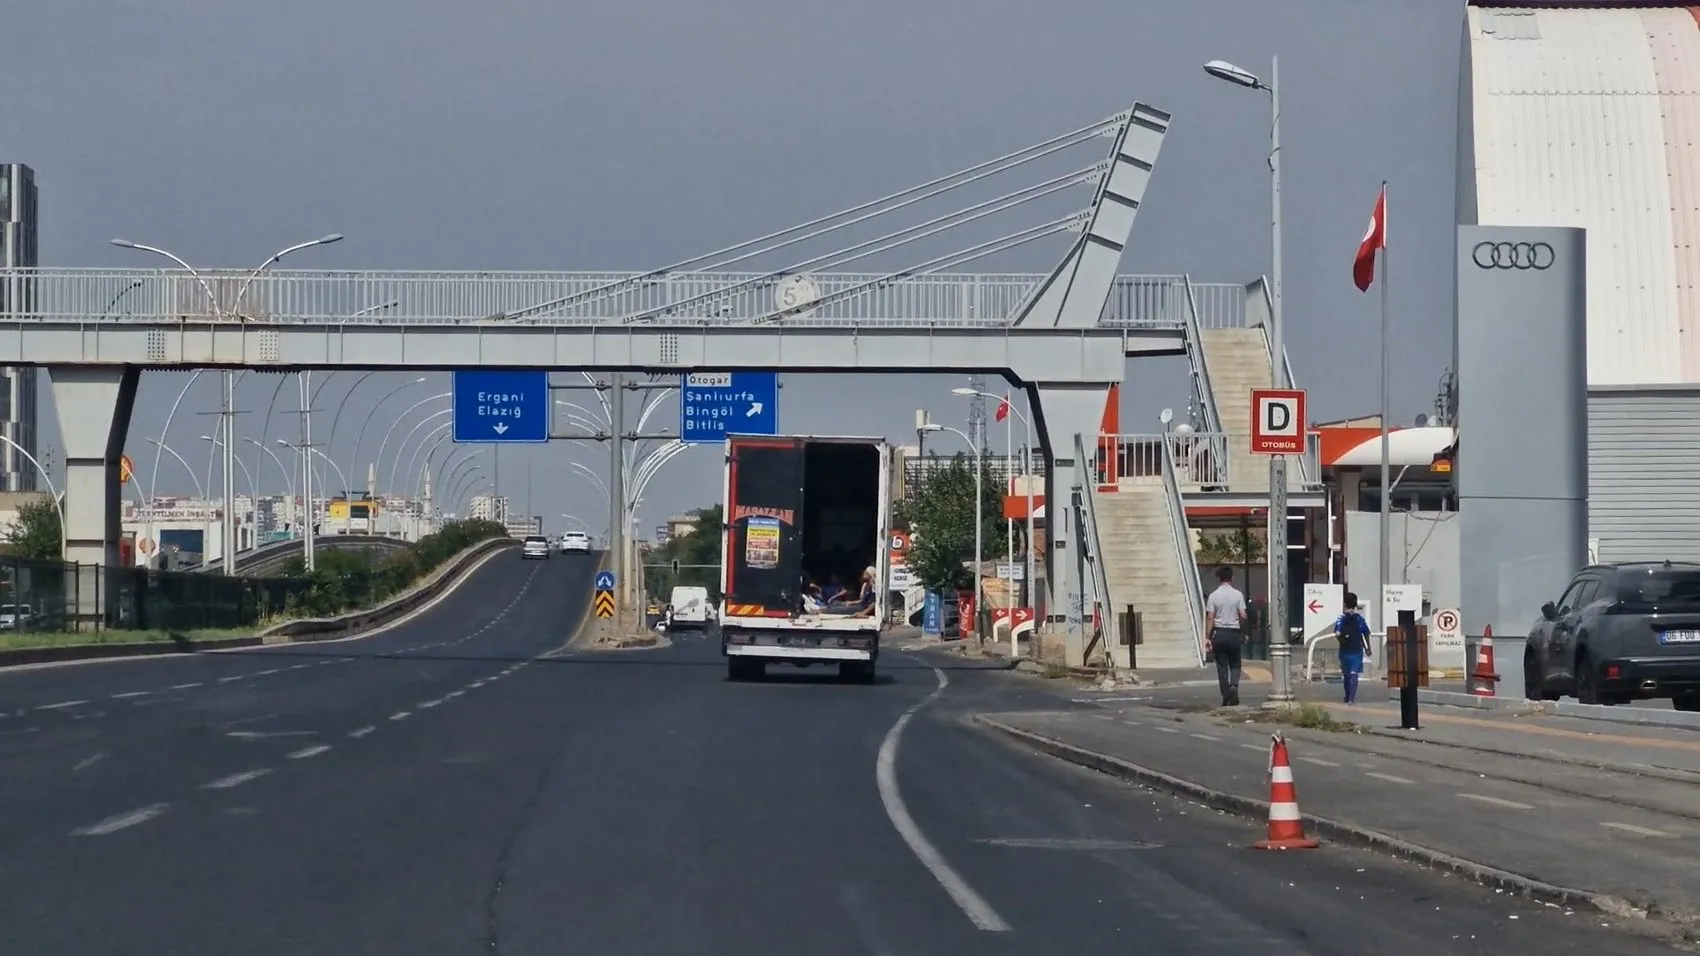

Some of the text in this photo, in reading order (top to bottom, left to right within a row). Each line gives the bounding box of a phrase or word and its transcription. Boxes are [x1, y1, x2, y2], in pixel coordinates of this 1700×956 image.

[689, 375, 729, 385] Otogar
[478, 391, 524, 405] Ergani
[686, 391, 755, 402] Şanlıurfa
[478, 405, 521, 418] Elazığ
[686, 406, 733, 419] Bingöl
[1267, 402, 1290, 431] D
[686, 420, 725, 430] Bitlis
[1261, 441, 1297, 449] OTOBÜS
